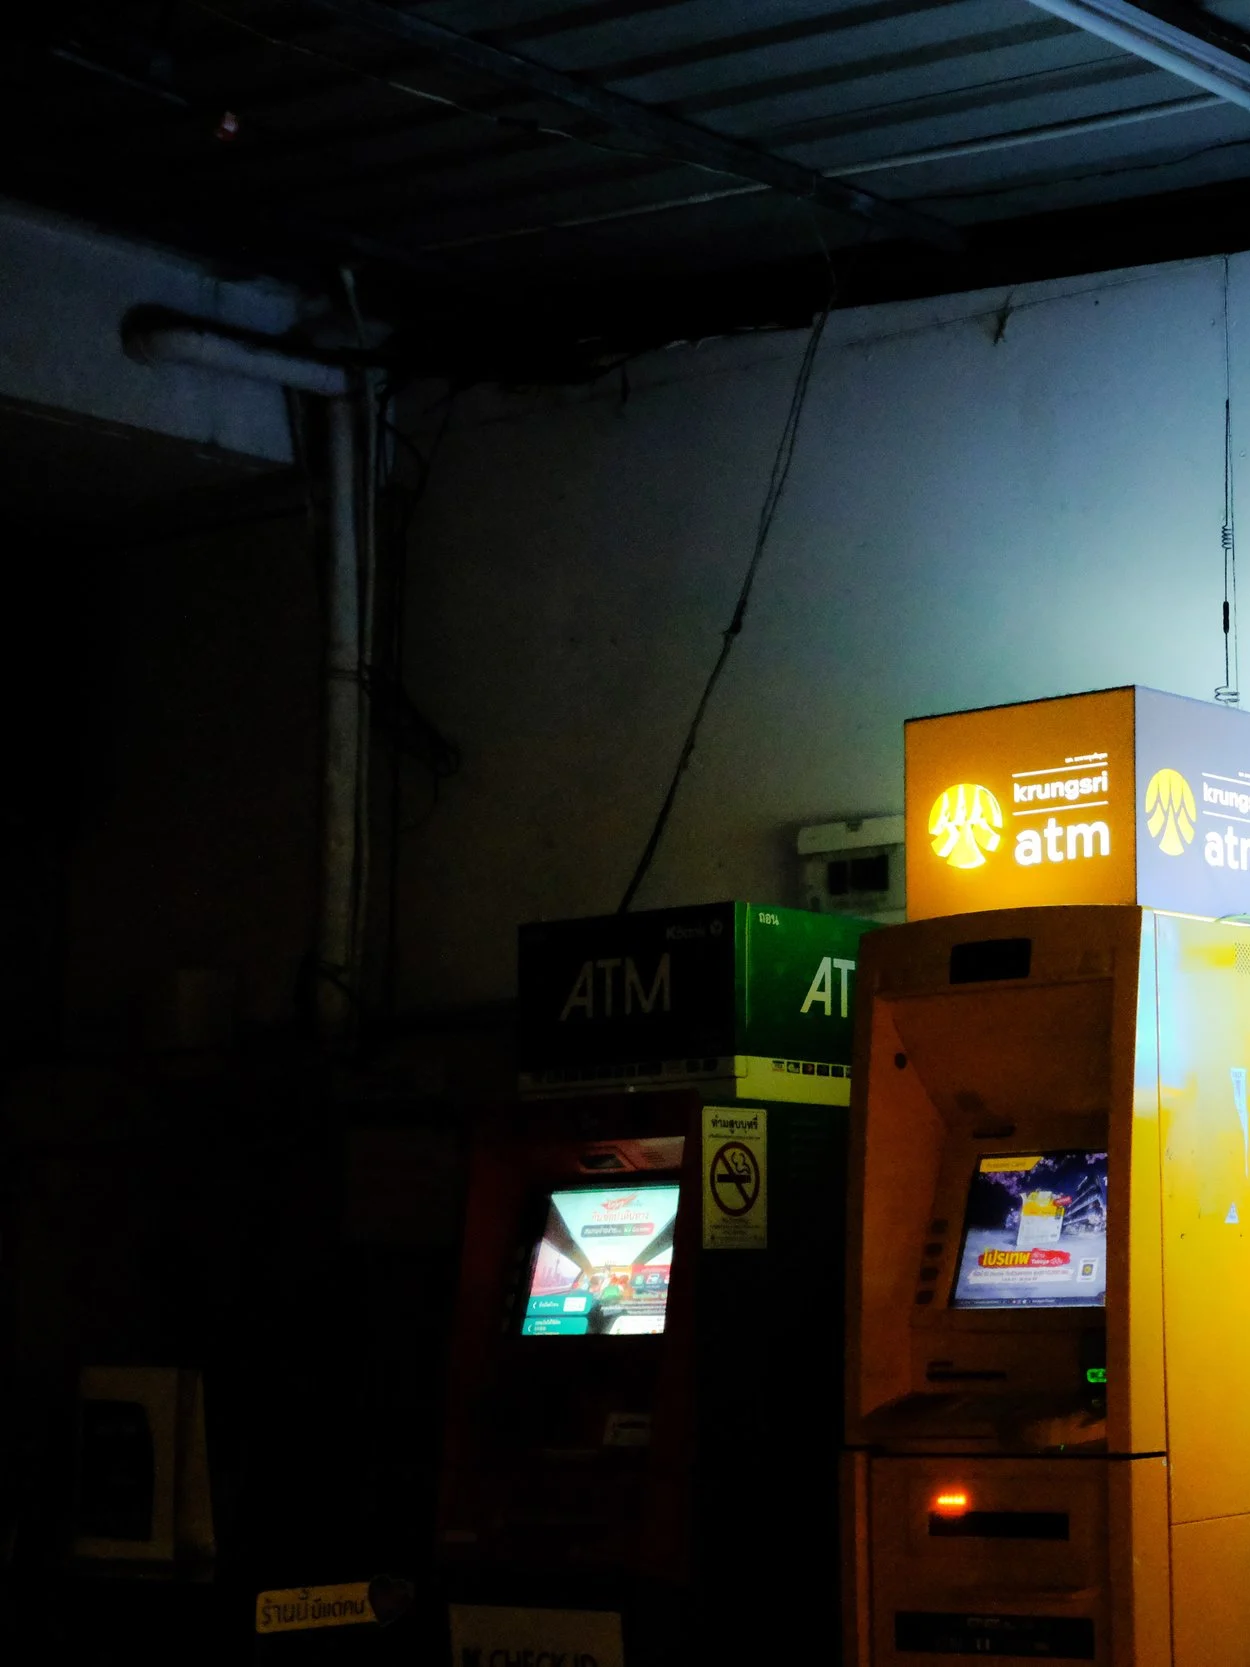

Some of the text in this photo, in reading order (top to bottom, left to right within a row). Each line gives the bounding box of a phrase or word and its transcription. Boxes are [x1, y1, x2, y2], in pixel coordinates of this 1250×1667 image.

[1013, 770, 1108, 803] krungsri
[1014, 817, 1111, 867] atm
[558, 951, 672, 1024] ATM
[800, 955, 857, 1018] AT
